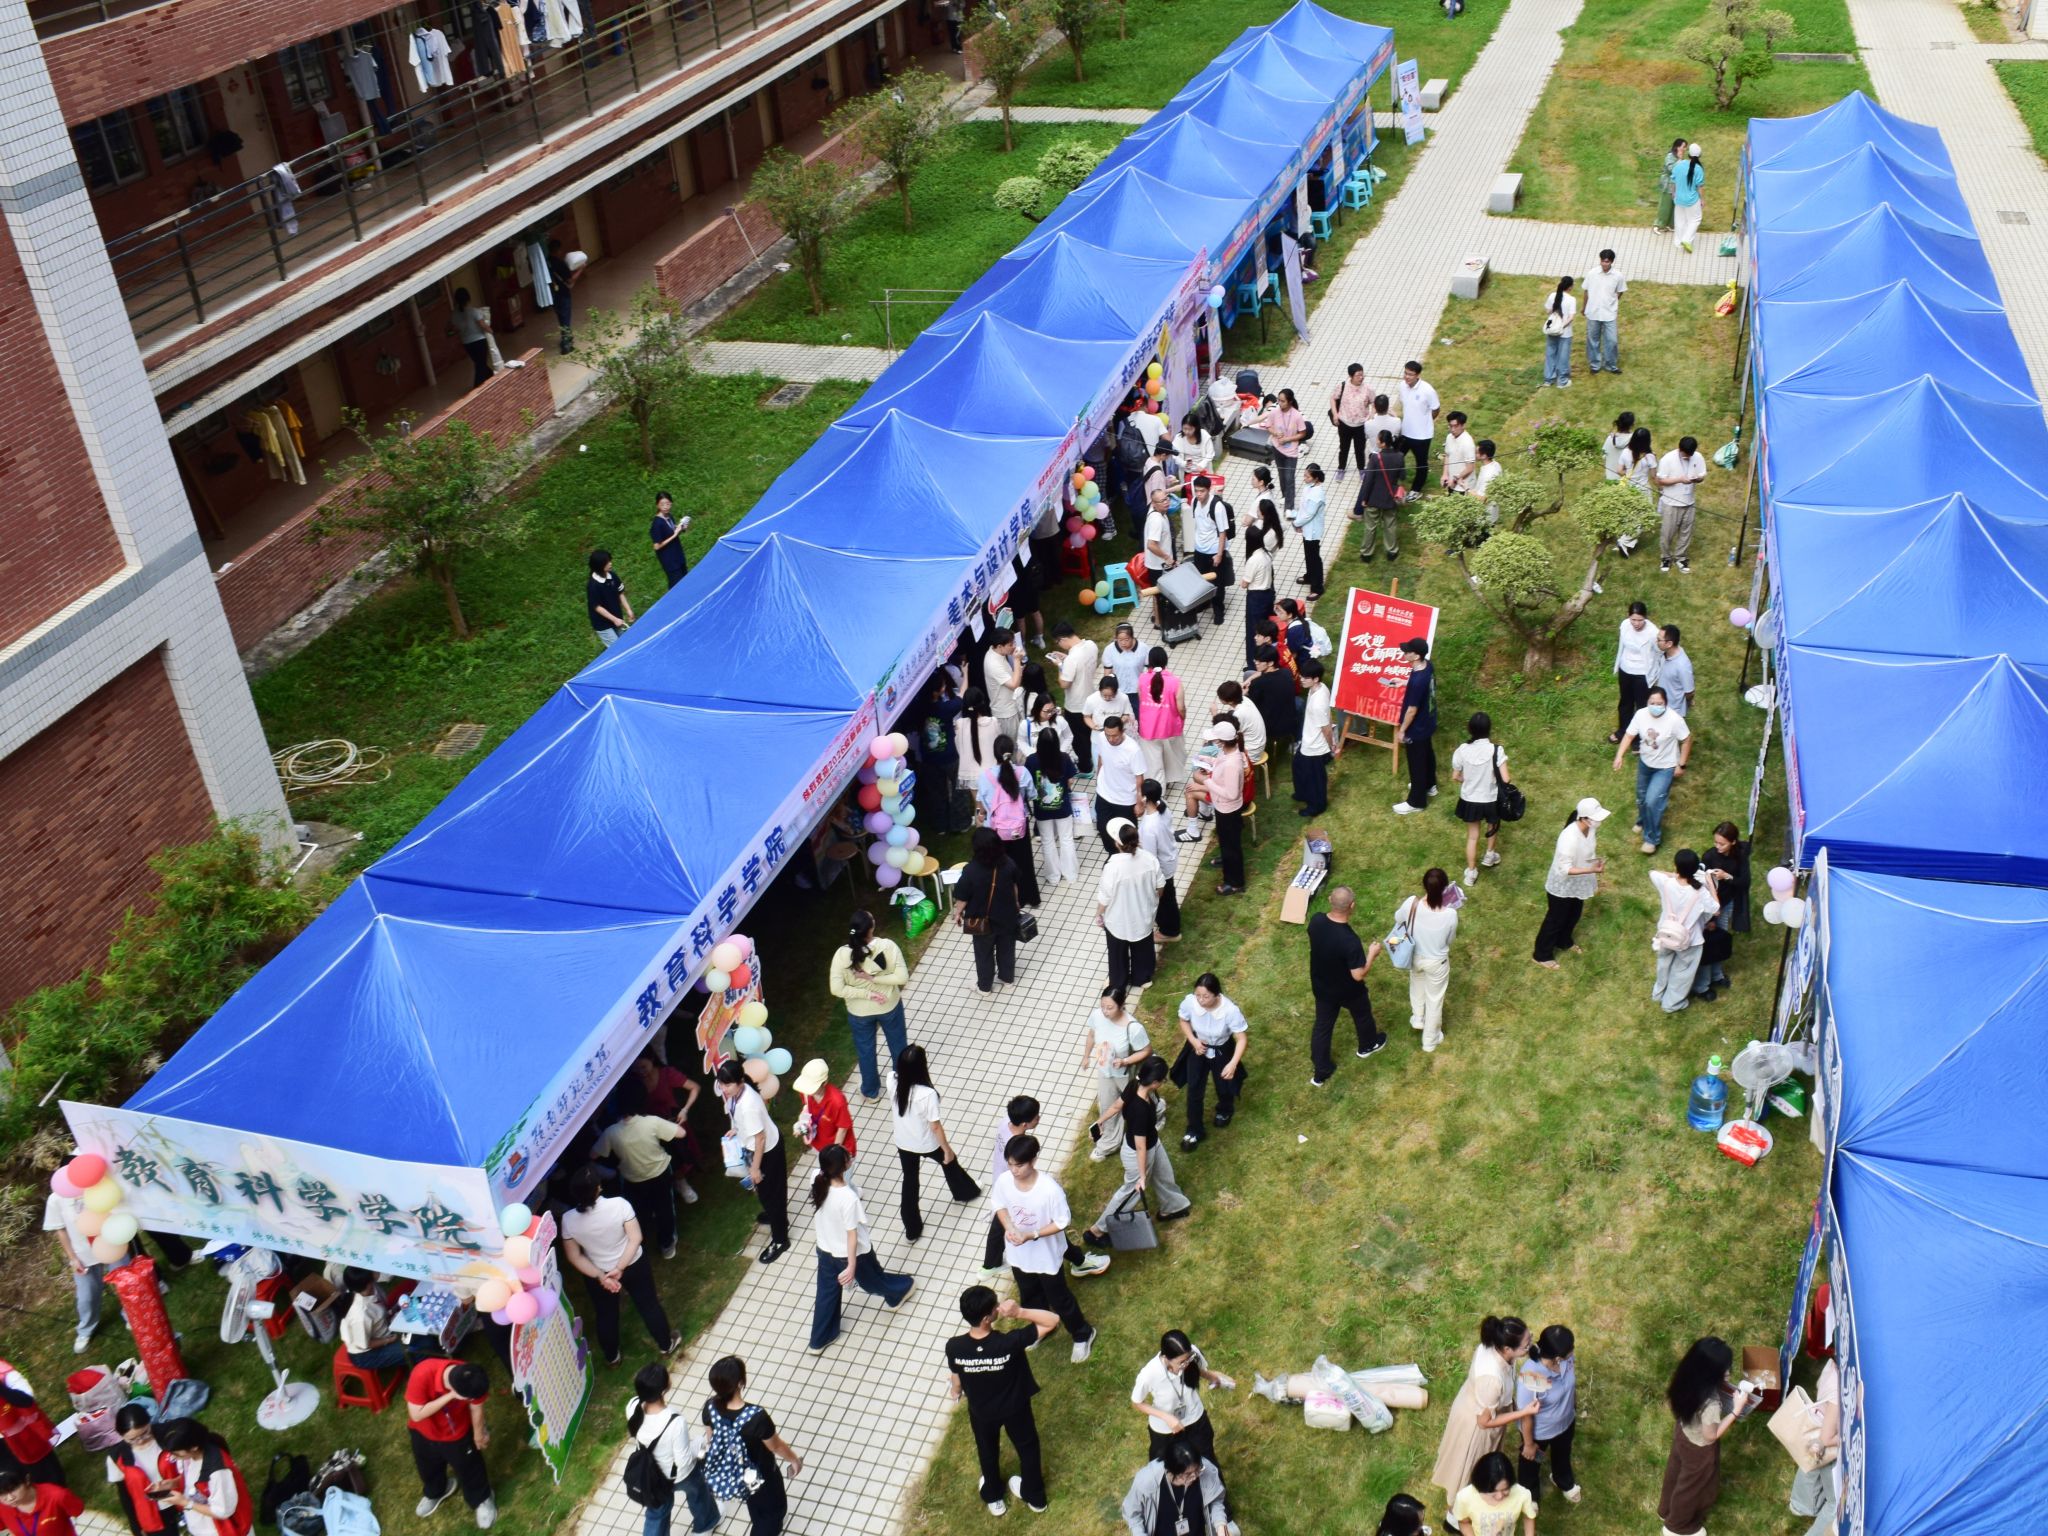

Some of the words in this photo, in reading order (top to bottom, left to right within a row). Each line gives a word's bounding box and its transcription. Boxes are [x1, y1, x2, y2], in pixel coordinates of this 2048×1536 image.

[946, 498, 1032, 626] 美术与设计学院
[1350, 631, 1386, 648] 欢迎
[634, 824, 788, 1031] 教育科学学院
[112, 1144, 481, 1251] 教育科学学院
[955, 1357, 992, 1366] MAINTAIN
[993, 1354, 1011, 1365] SELF
